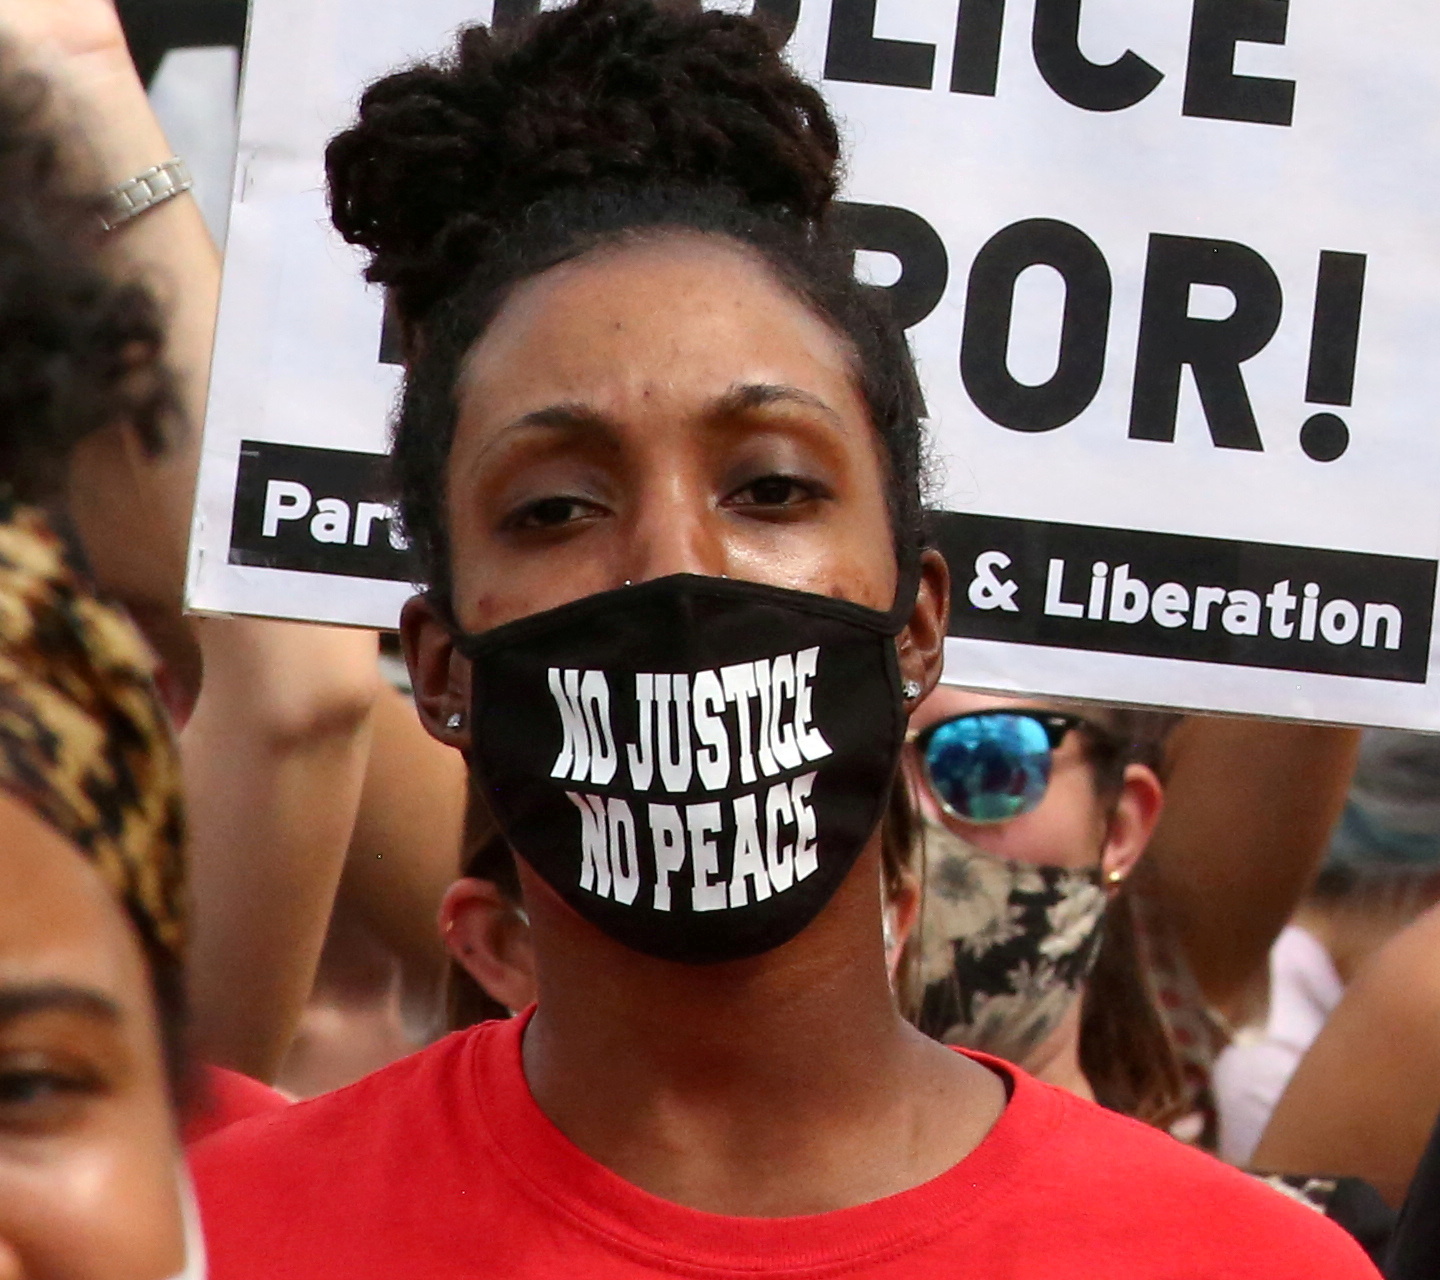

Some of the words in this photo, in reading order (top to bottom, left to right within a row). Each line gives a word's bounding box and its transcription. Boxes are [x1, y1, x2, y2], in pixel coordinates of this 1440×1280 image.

[967, 550, 1020, 614] &
[1043, 556, 1403, 650] Liberation
[547, 667, 618, 786] NO
[626, 645, 834, 793] JUSTICE
[565, 790, 640, 907] NO
[648, 770, 819, 912] PEACE
